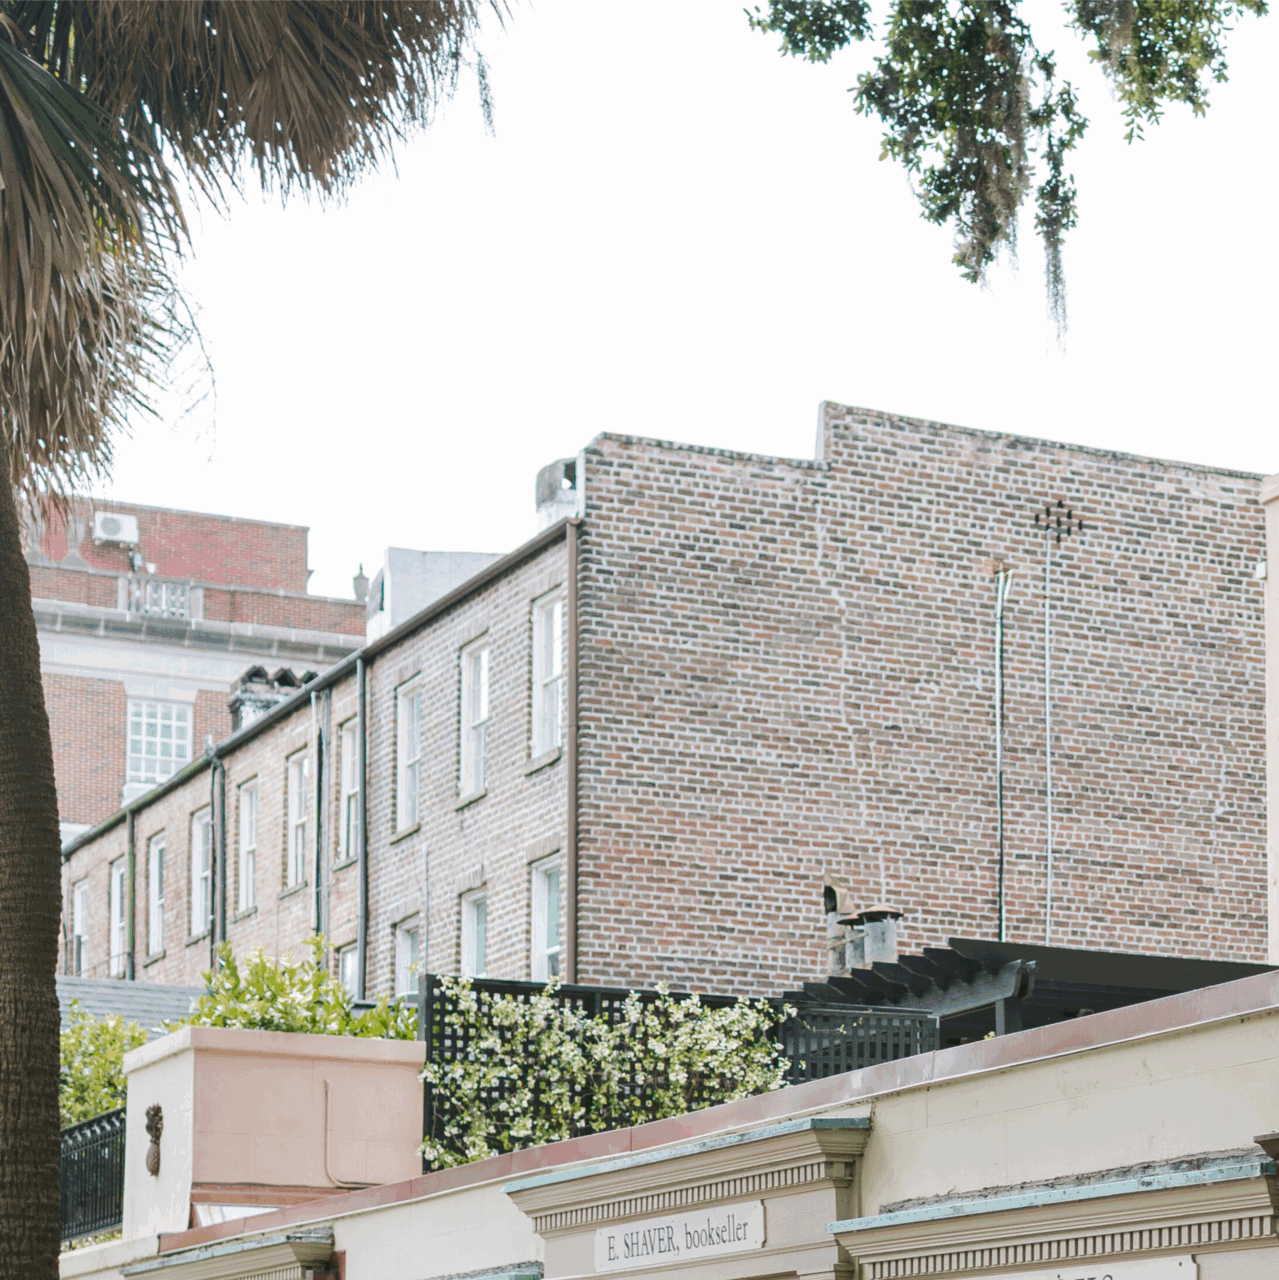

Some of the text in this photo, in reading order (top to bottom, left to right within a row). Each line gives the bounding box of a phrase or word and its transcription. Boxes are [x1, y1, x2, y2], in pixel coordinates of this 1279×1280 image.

[607, 1213, 749, 1261] E. SHAVER, bookseller
